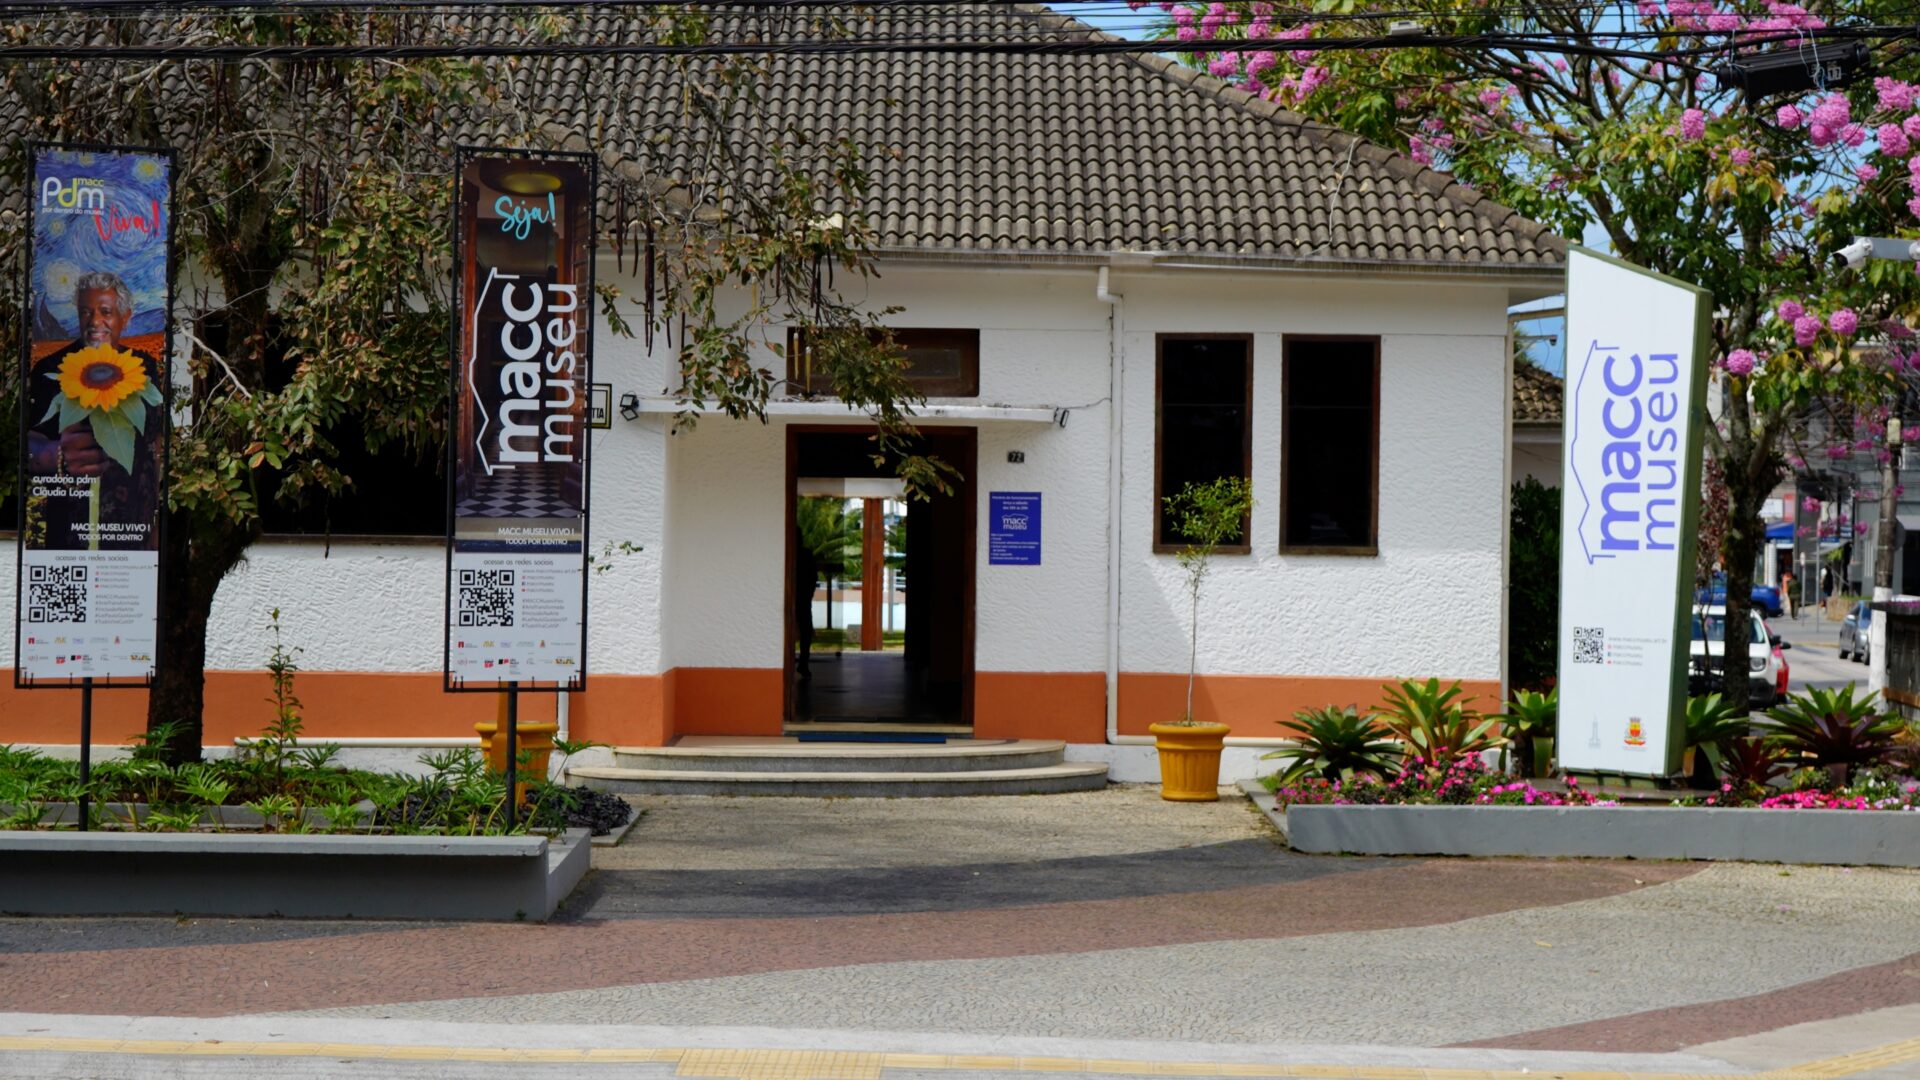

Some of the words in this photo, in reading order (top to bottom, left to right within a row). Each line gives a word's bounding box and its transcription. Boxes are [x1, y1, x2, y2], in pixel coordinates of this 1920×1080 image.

[78, 178, 105, 187] macc
[92, 199, 160, 241] Viva!
[494, 192, 557, 240] Seja!
[498, 282, 544, 463] macc
[544, 284, 578, 462] museu
[1600, 353, 1644, 551] macc
[1646, 353, 1679, 550] museu
[32, 474, 74, 484] curadoria
[69, 487, 94, 499] Lopes
